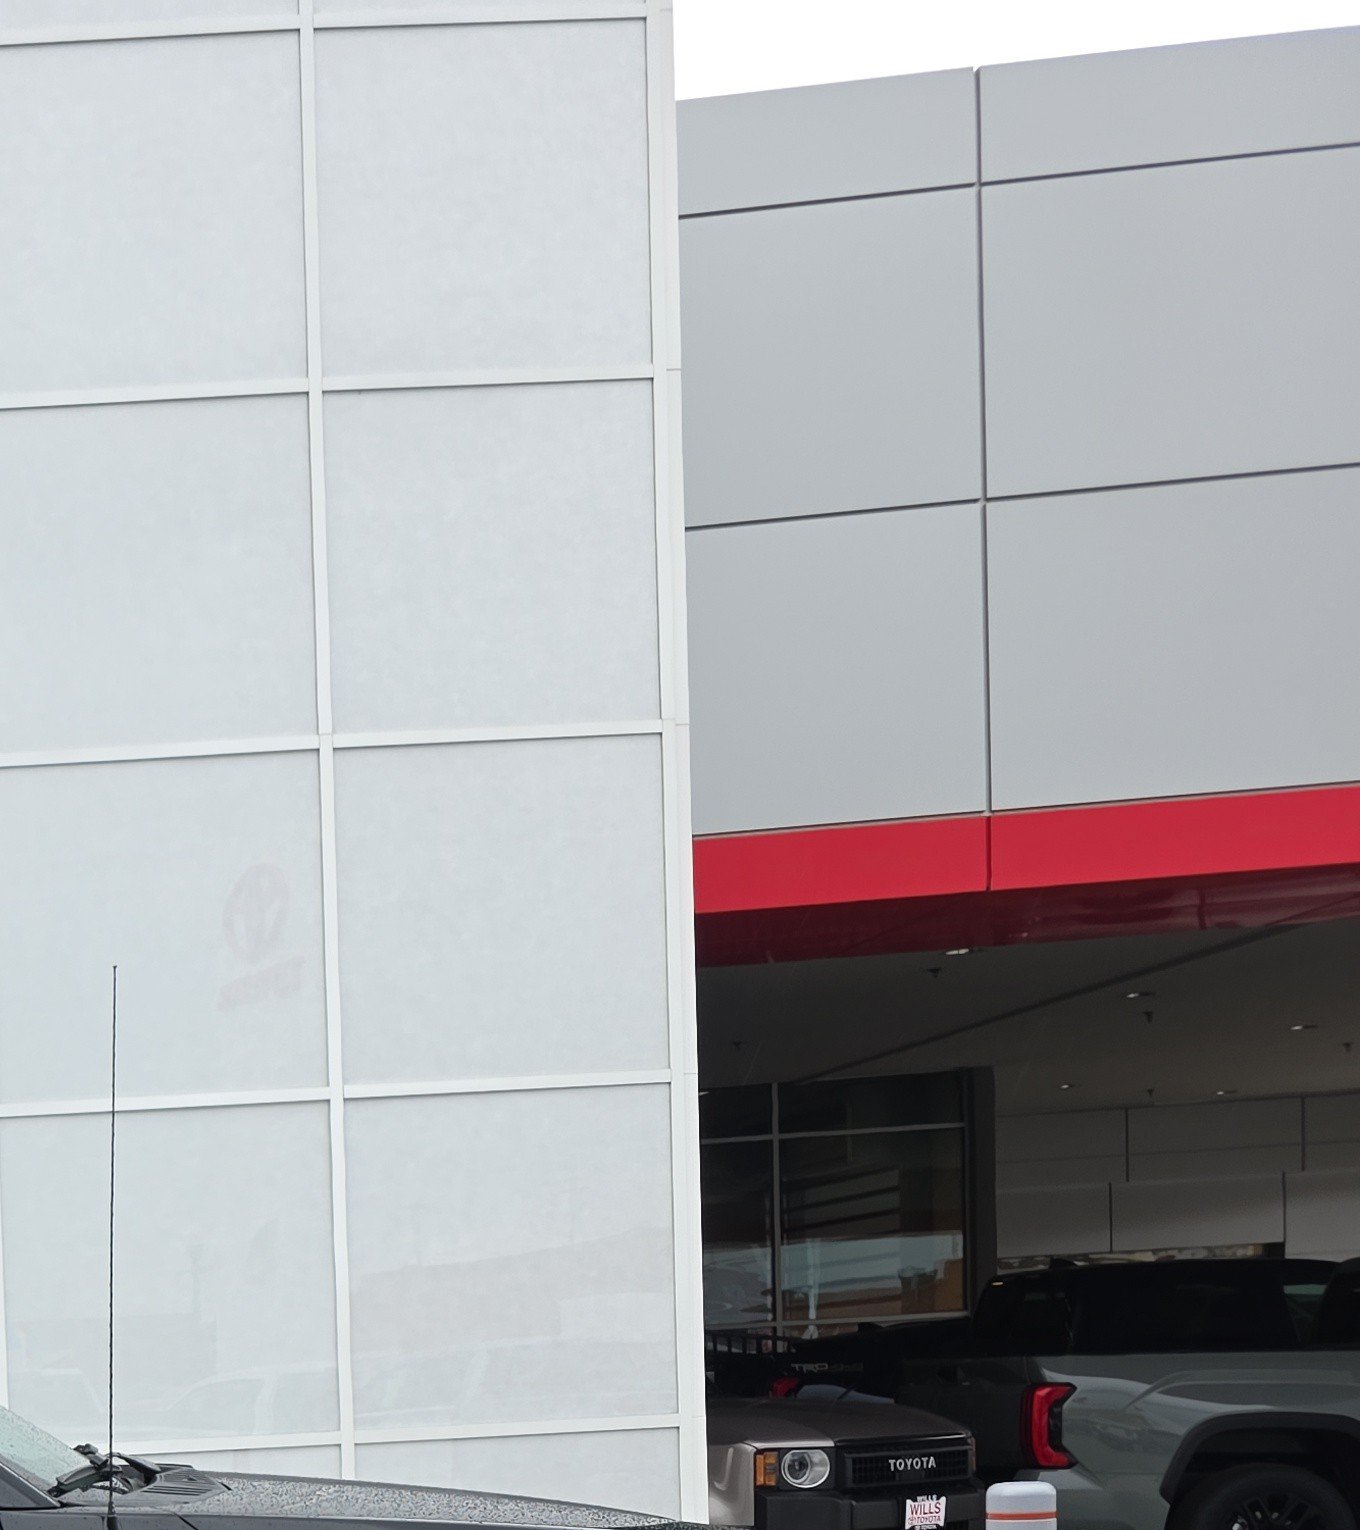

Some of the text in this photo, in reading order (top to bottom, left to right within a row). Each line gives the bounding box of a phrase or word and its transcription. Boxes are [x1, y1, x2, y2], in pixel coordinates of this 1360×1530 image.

[888, 1456, 937, 1471] TOYOTA
[910, 1501, 942, 1516] WILLS
[916, 1515, 942, 1524] TOYOTA
